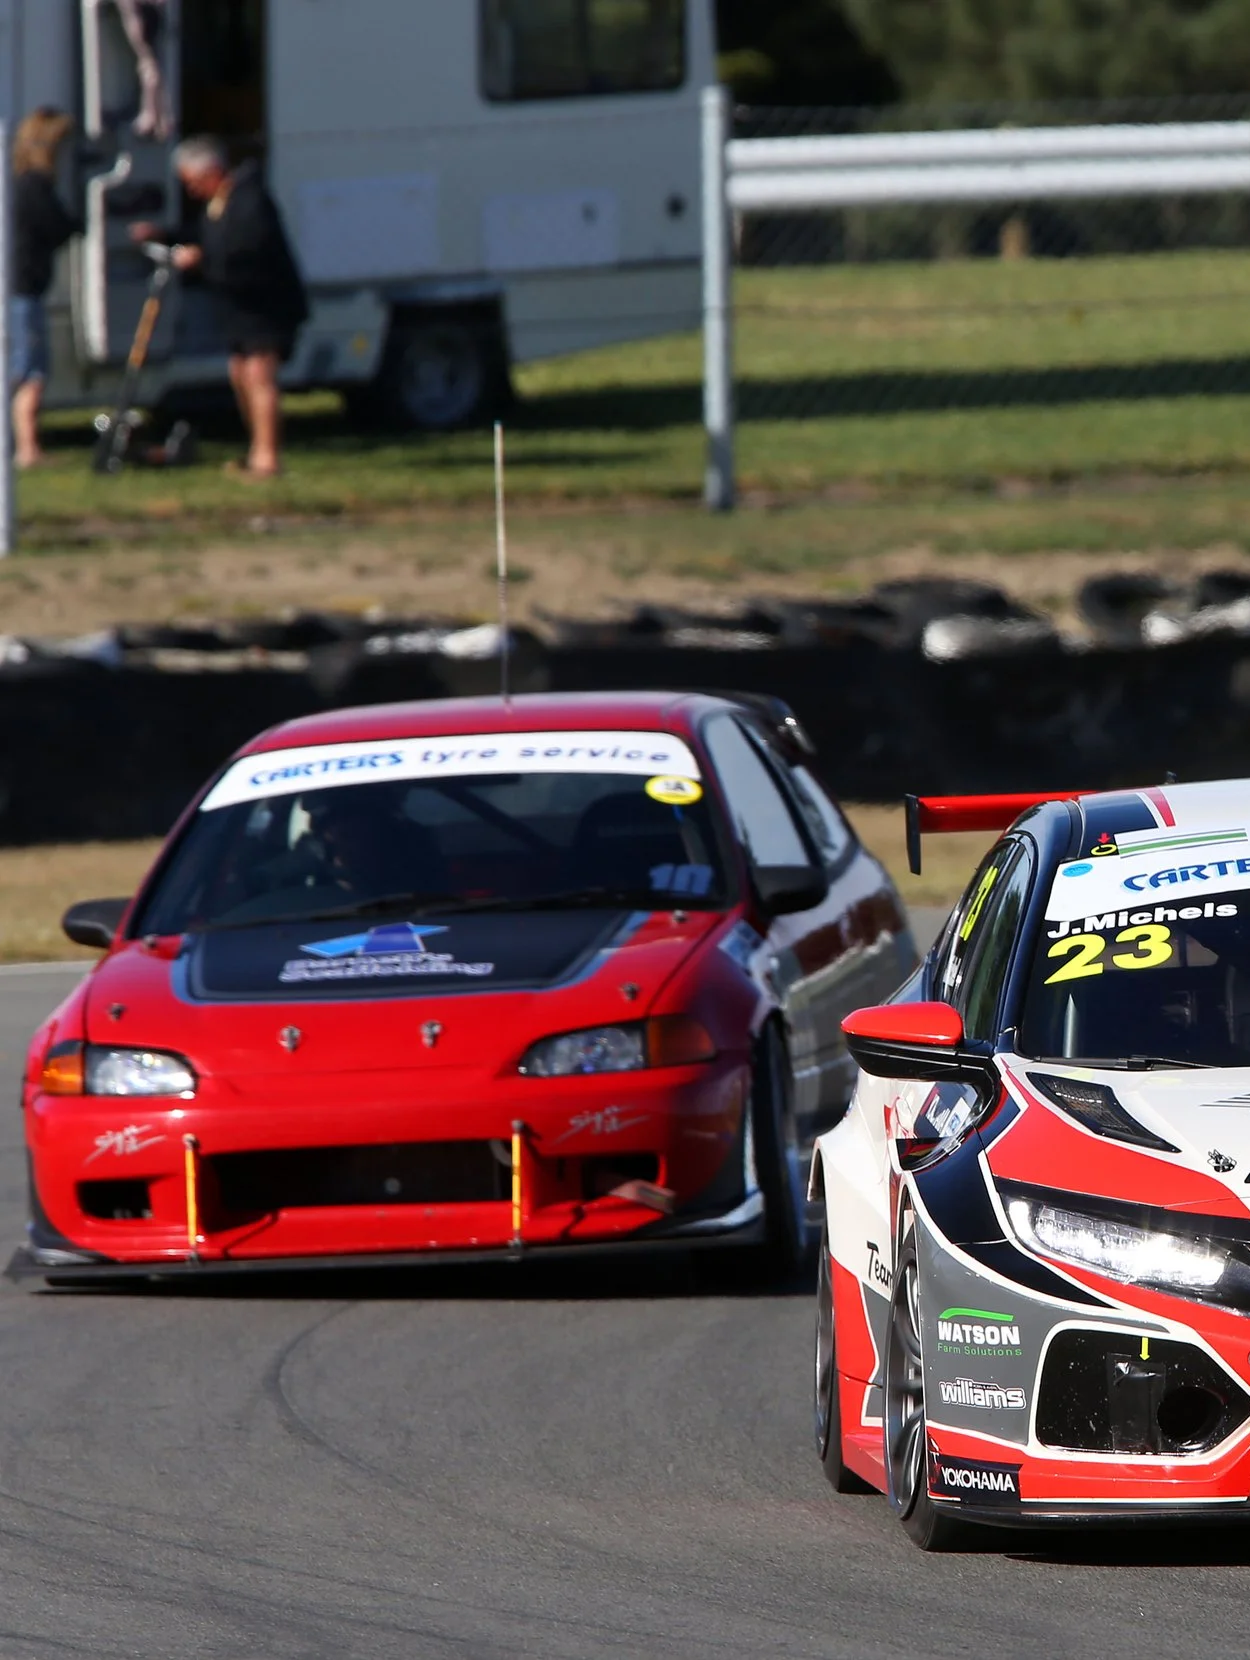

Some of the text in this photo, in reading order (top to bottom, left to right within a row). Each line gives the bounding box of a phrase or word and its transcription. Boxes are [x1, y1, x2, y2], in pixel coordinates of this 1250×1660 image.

[421, 748, 497, 763] tyre
[519, 745, 670, 762] service
[1047, 902, 1238, 939] J.Michels
[1044, 924, 1173, 985] 23
[937, 1320, 1020, 1345] WATSON
[938, 1342, 1022, 1356] Farm Solutions
[940, 1379, 1025, 1408] williams
[941, 1466, 1016, 1492] YOKOHAMA
